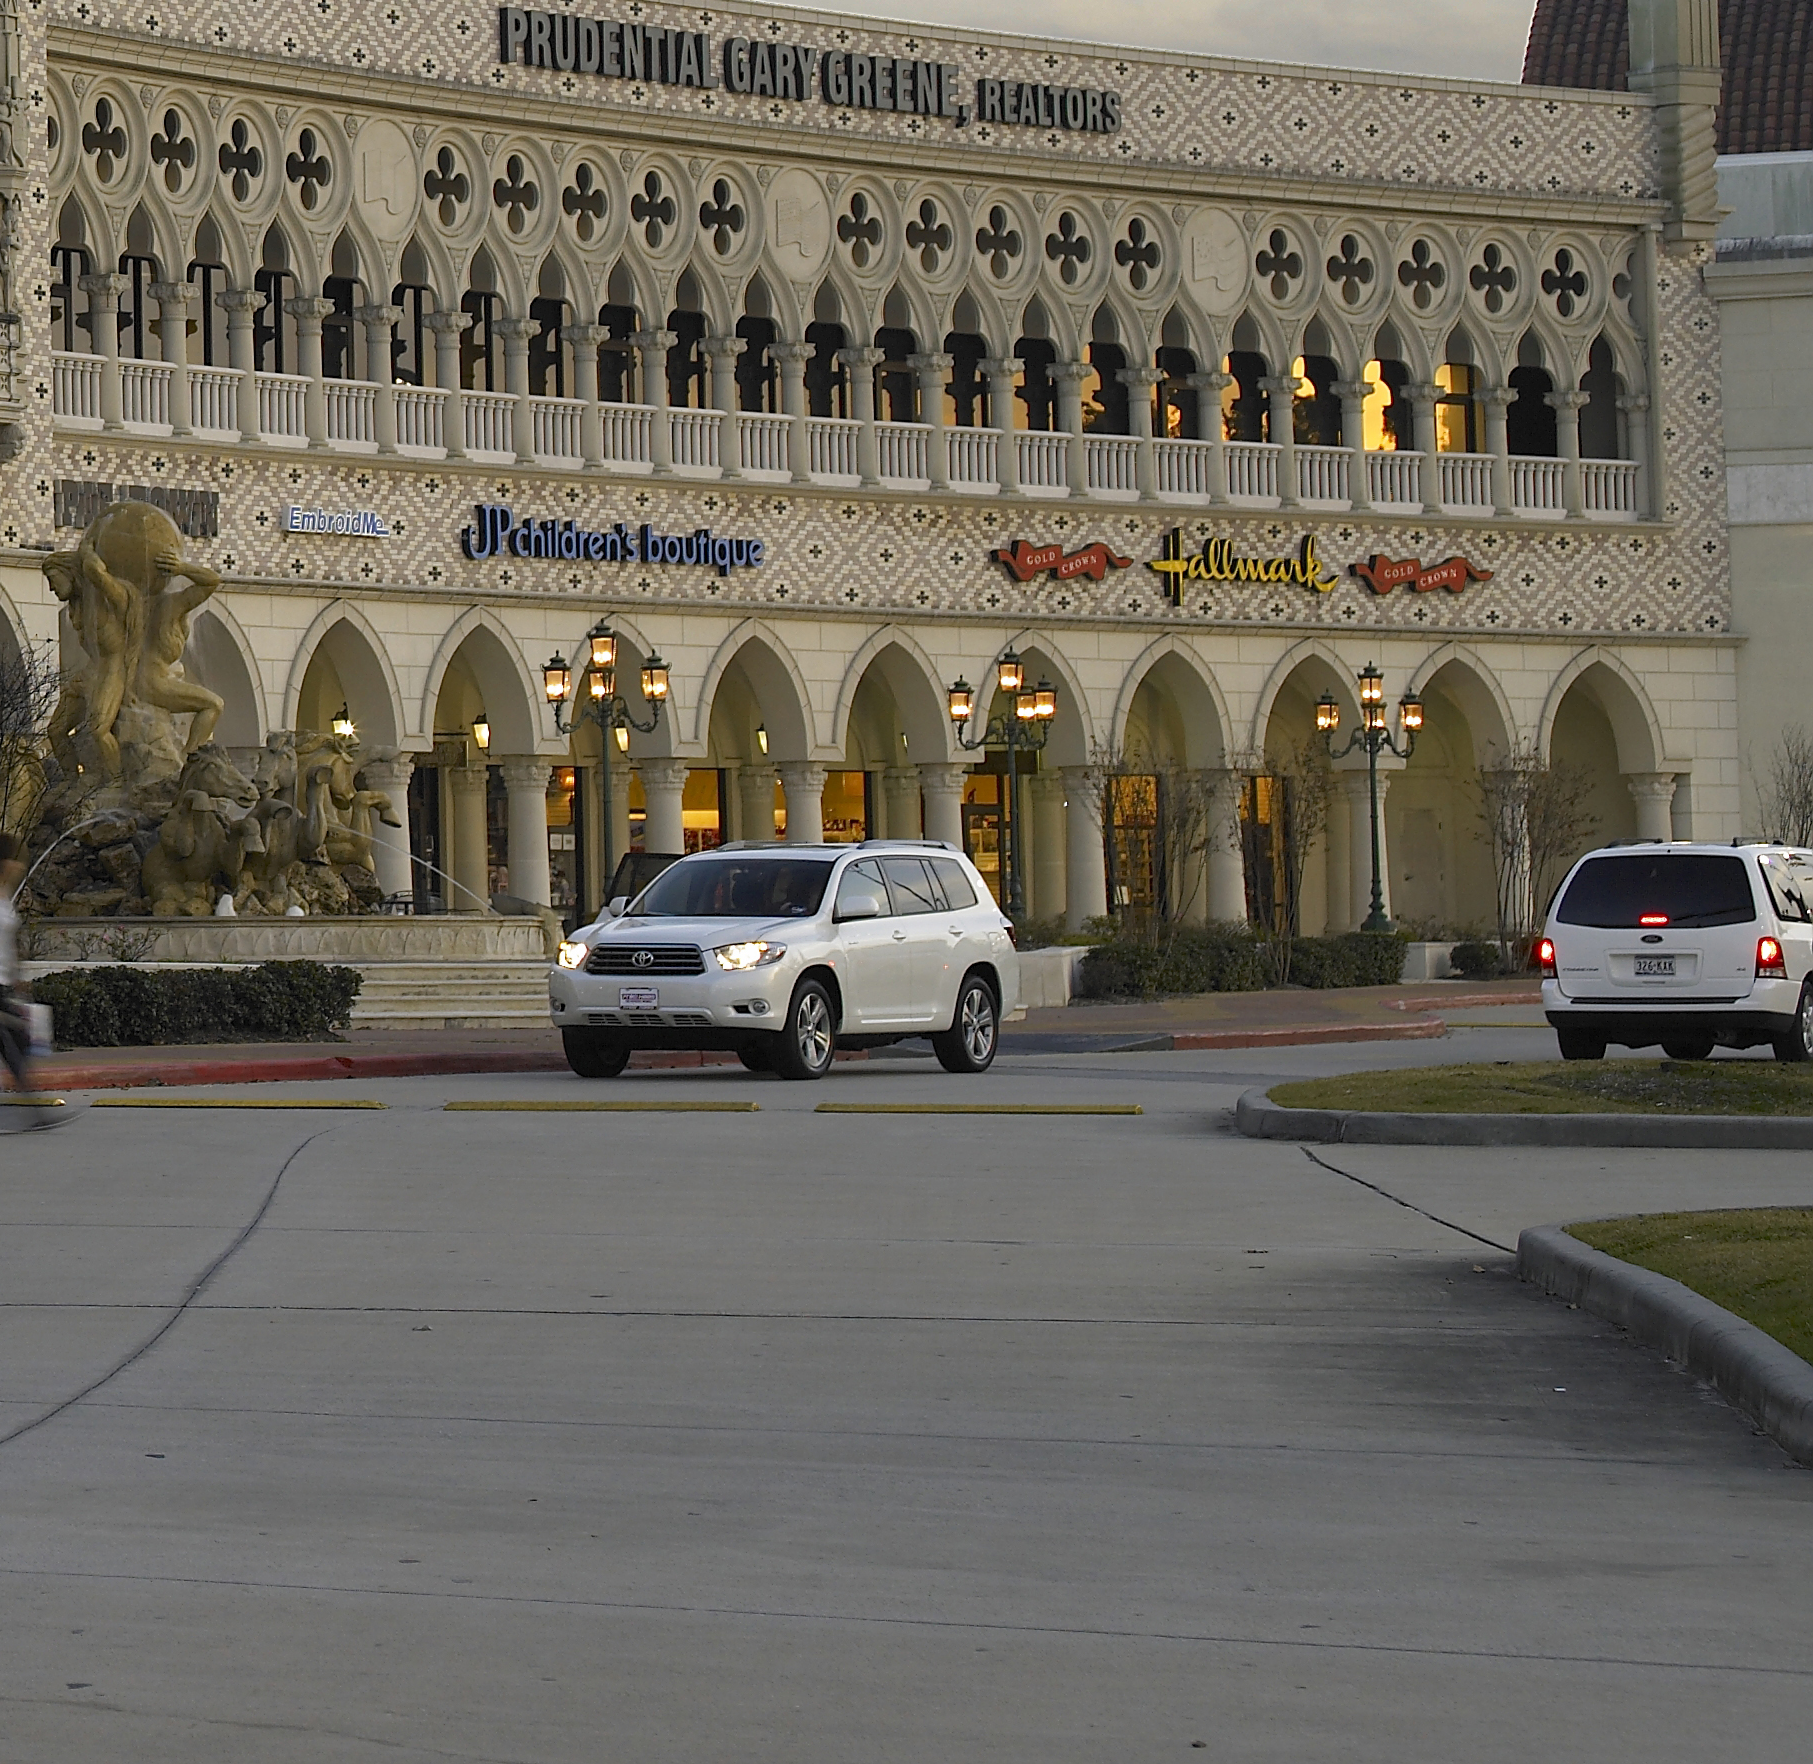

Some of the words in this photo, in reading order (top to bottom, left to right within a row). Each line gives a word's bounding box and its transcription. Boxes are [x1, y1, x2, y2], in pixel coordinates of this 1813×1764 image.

[506, 7, 719, 88] PRUDENTIAL
[731, 36, 818, 101] GARY
[828, 50, 971, 128] GREENE,
[984, 78, 1121, 133] REALTORS
[288, 505, 390, 536] EmbroidMe
[469, 504, 514, 560] JP
[515, 518, 639, 562] children's
[646, 523, 765, 577] boutique
[1026, 551, 1056, 565] GOLD
[1061, 554, 1098, 574] CROWN
[1148, 526, 1340, 606] Hallmark
[1384, 564, 1415, 579] GOLD
[1419, 568, 1458, 587] CROWN
